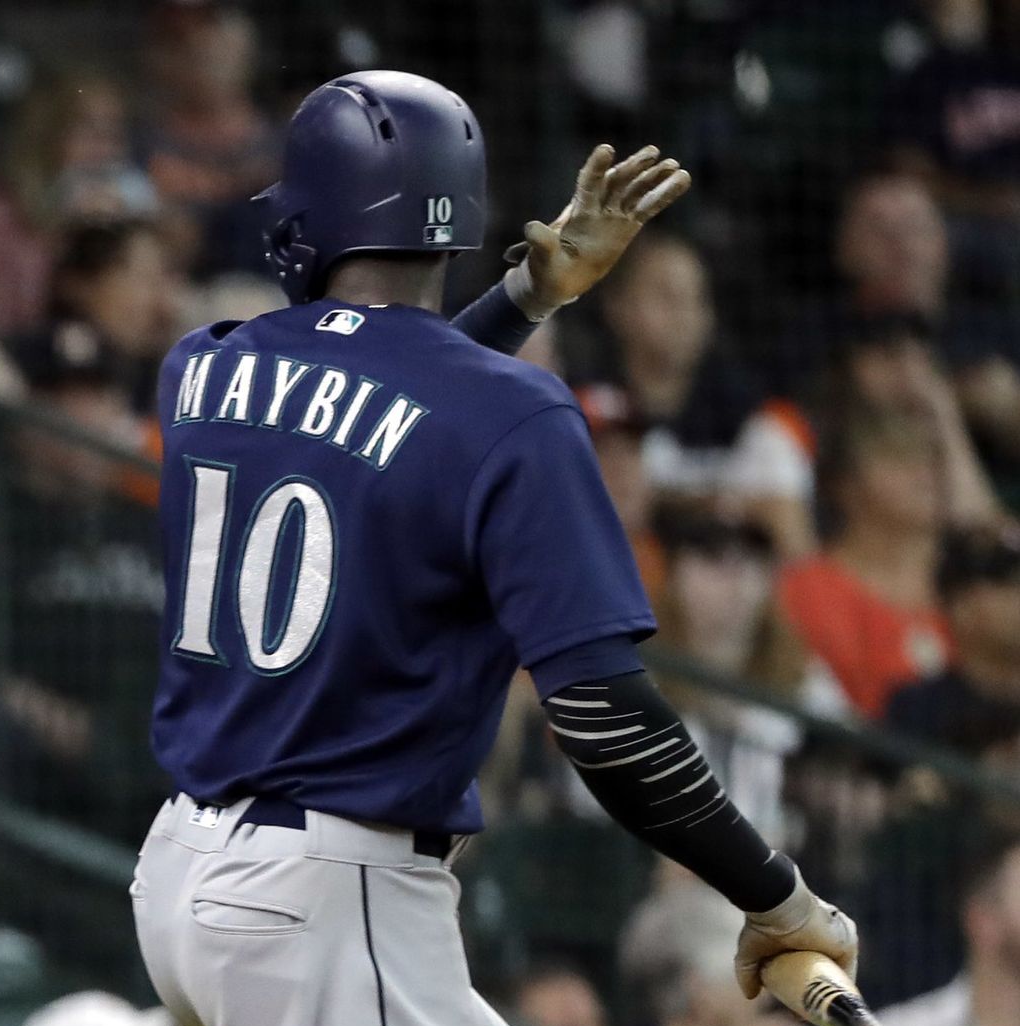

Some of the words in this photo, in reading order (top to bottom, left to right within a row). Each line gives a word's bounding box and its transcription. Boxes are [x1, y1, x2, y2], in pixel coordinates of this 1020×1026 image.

[427, 196, 452, 224] 10
[172, 349, 430, 471] MAYBIN
[171, 454, 339, 677] 10
